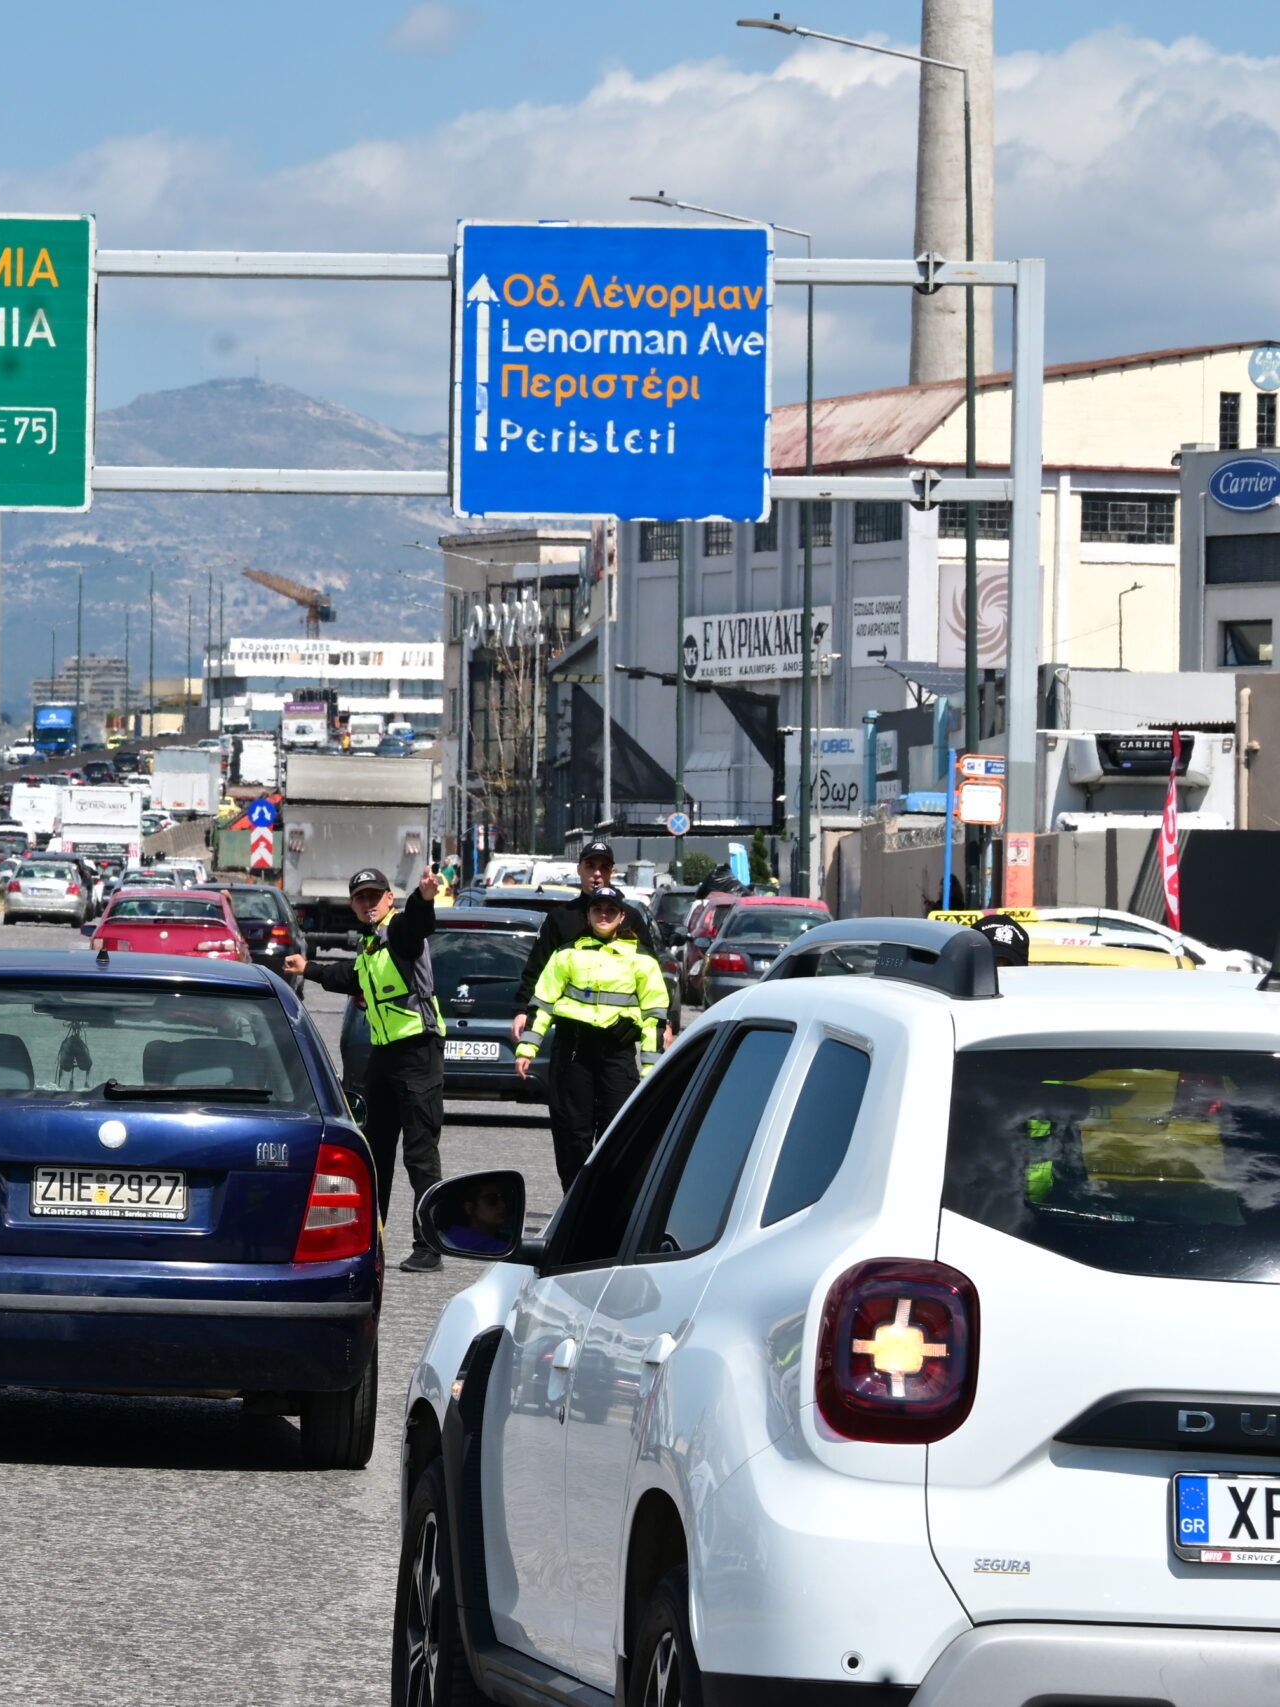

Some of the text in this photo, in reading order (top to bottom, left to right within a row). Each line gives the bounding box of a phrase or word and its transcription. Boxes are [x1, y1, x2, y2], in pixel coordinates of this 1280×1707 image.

[503, 273, 764, 317] Οδ. Λένορμαν
[502, 319, 764, 355] Lenorman Ave
[501, 364, 700, 408] Περιστέρι
[500, 418, 675, 454] Peristeri
[1219, 471, 1277, 495] Carrier
[936, 915, 977, 926] TAXI
[43, 1207, 88, 1216] Kantzos
[1181, 1519, 1206, 1534] GR
[973, 1558, 1031, 1573] SEGURA
[1236, 1554, 1276, 1562] SERVICE
